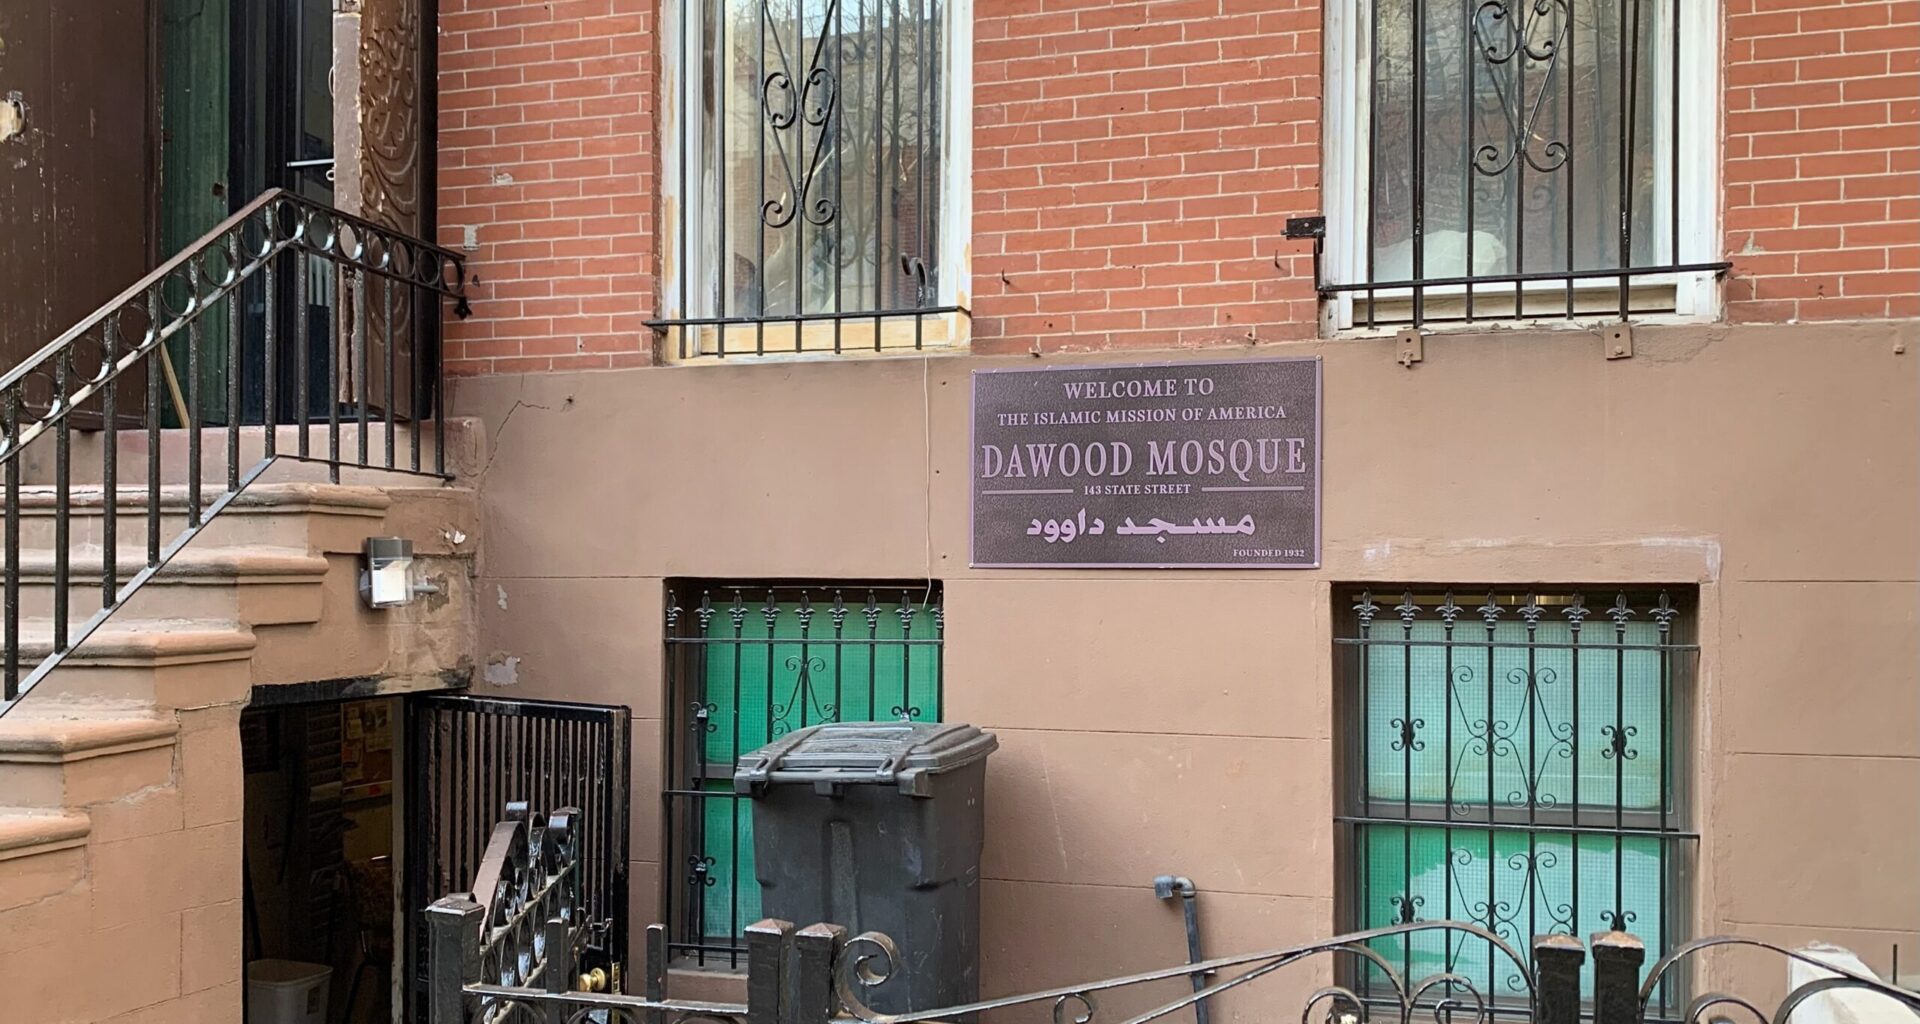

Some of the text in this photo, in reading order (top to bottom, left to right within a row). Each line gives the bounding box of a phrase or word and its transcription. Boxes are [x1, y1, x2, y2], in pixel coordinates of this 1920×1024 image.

[1064, 378, 1214, 399] WELCOME TO
[998, 406, 1286, 426] THE ISLAMIC MISSION OF AMERICA
[982, 438, 1306, 482] DAWOOD MOSQUE
[1084, 484, 1191, 495] 143 STATE STREET
[1027, 508, 1255, 543] مسجد داوود
[1233, 549, 1281, 557] FOUNDED
